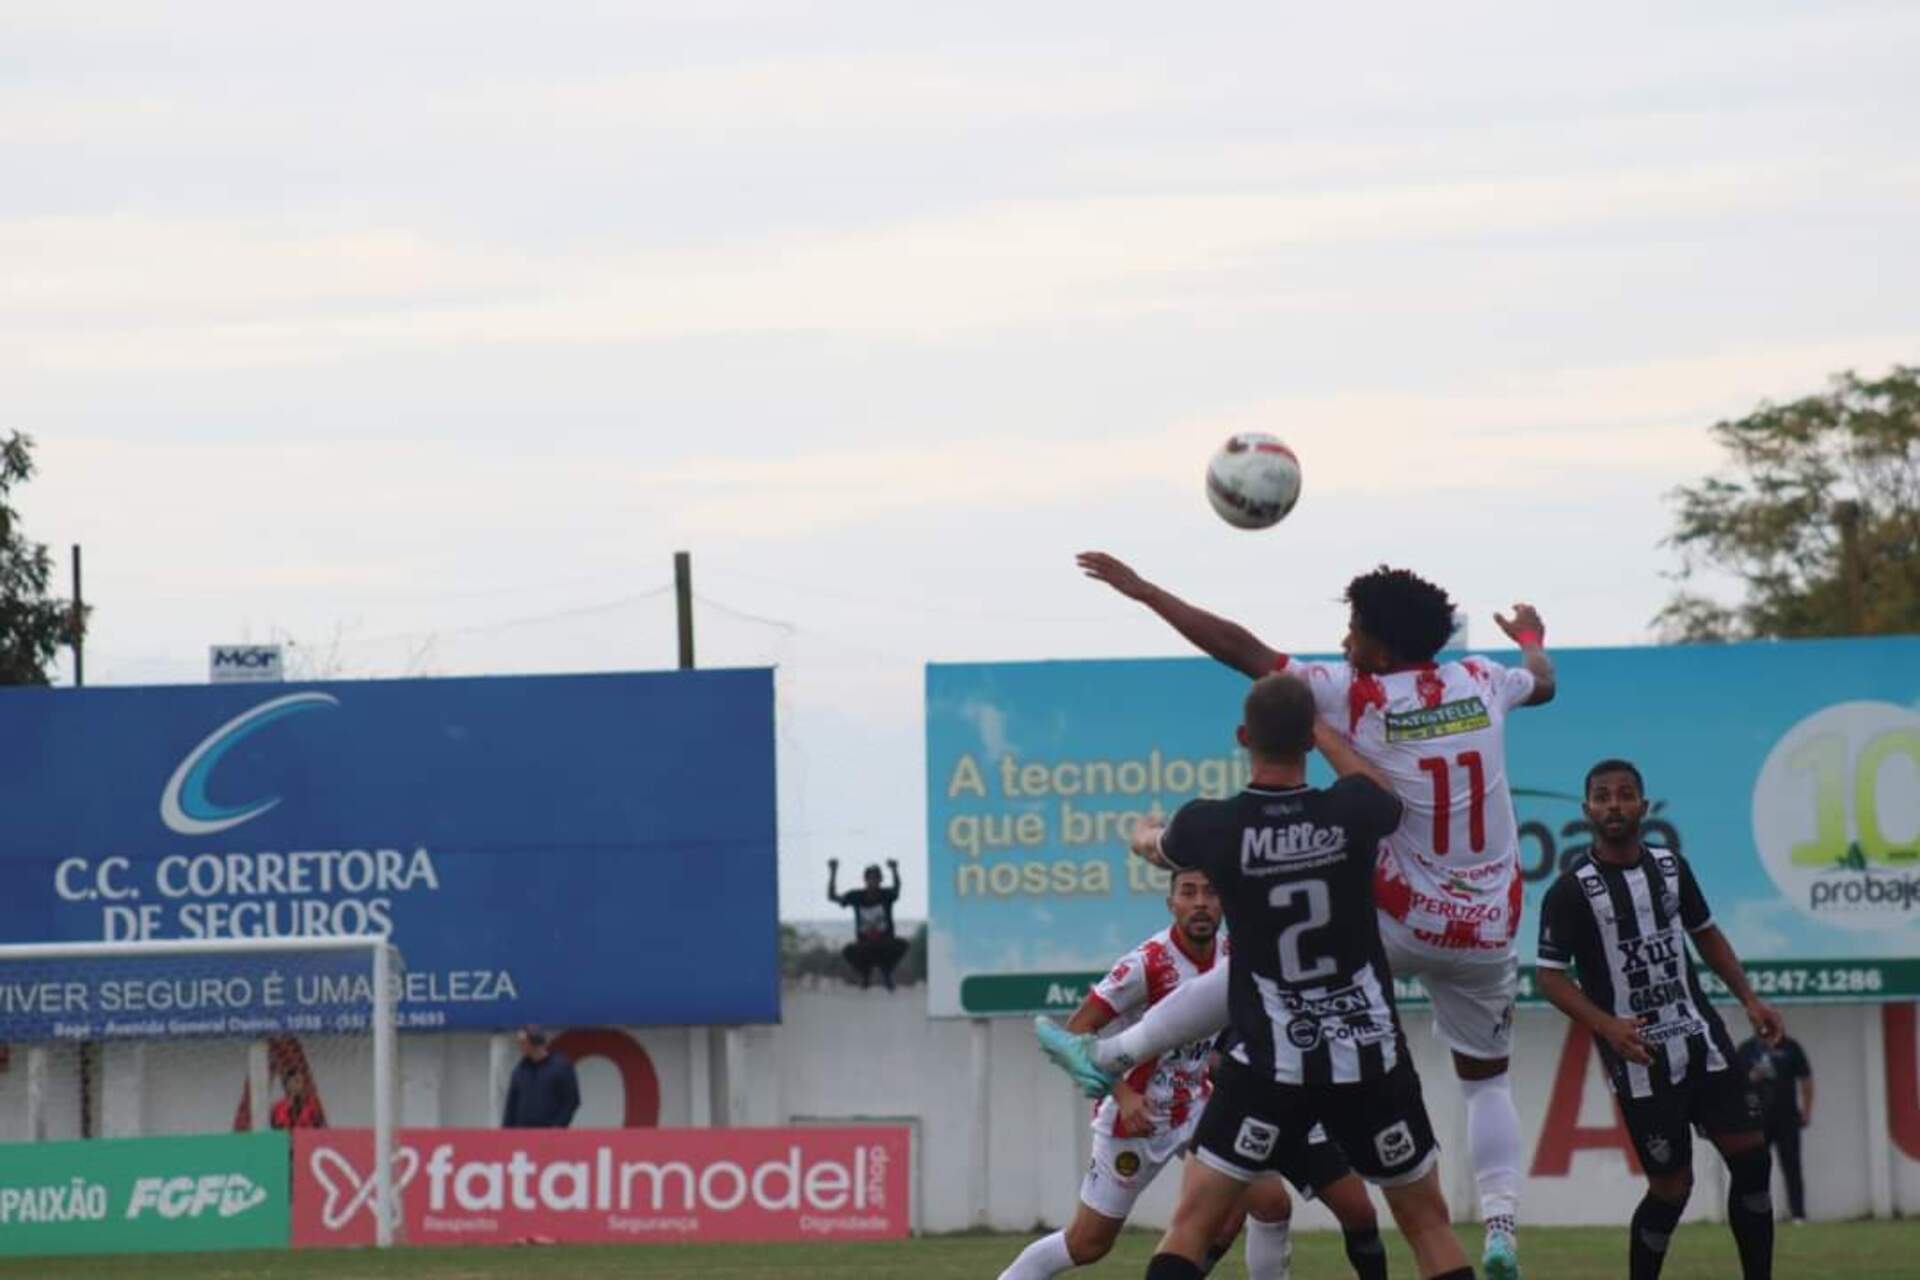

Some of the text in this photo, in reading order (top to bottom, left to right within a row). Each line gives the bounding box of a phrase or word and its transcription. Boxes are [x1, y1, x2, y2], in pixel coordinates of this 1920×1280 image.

[950, 749, 1250, 801] A tecnologi
[1418, 751, 1485, 856] 11
[949, 812, 1046, 857] que
[55, 848, 439, 900] C.C. CORRETORA
[957, 859, 1110, 897] nossa
[103, 899, 393, 941] DE SEGUROS
[1412, 893, 1501, 922] PERUZZO
[1268, 878, 1337, 983] 2
[0, 983, 89, 1014] IVER
[100, 978, 253, 1011] SEGURO
[263, 970, 285, 1007] É
[296, 974, 377, 1004] UMA
[1047, 983, 1083, 1006] Av.
[0, 1176, 107, 1223] PAIXÃO
[425, 1144, 869, 1211] fatalmodel
[800, 1213, 888, 1232] Dignidade
